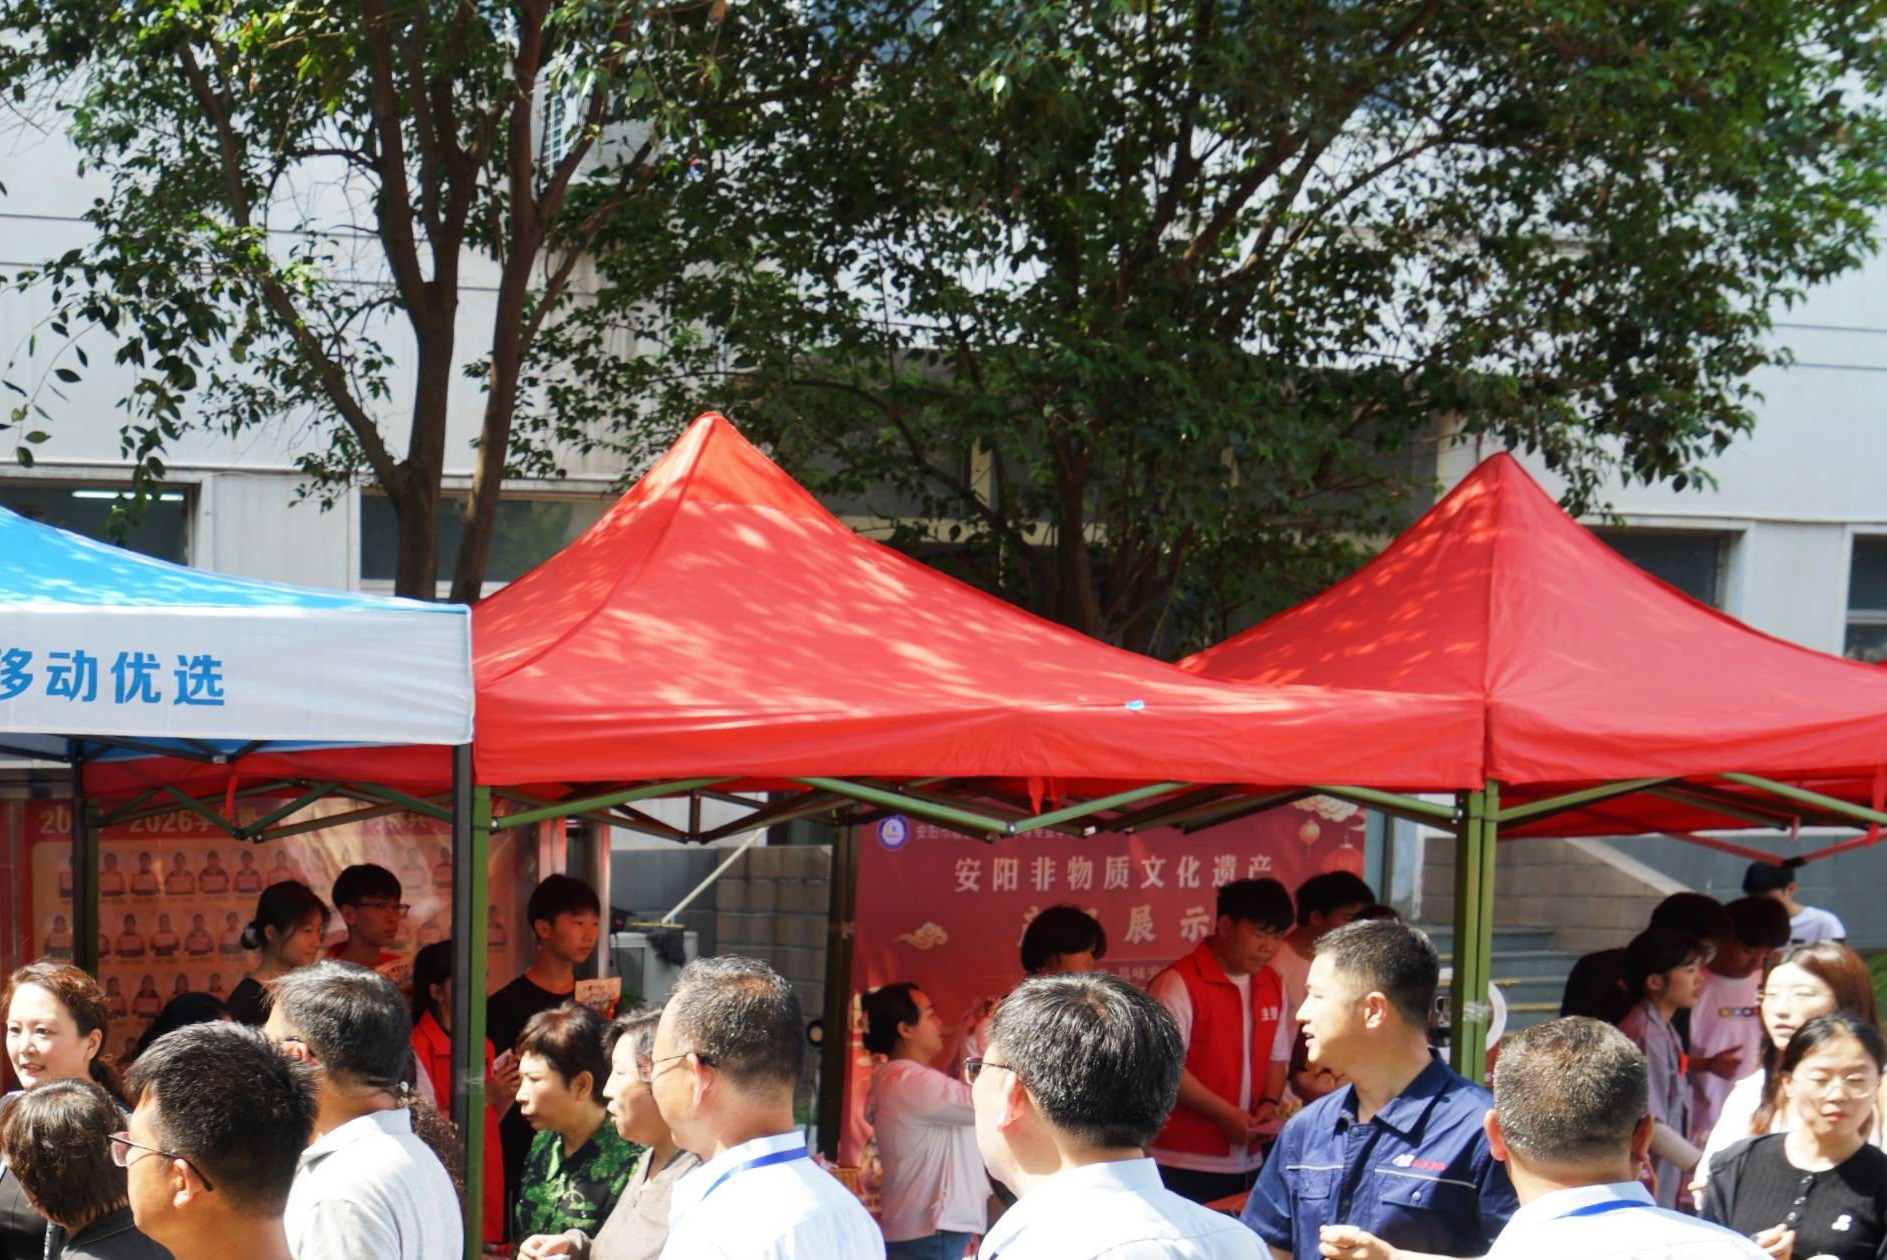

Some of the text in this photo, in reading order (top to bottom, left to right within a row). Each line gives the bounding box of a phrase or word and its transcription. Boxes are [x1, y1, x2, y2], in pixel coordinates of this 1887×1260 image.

[955, 855, 1272, 893] 安阳非物质文化遗产
